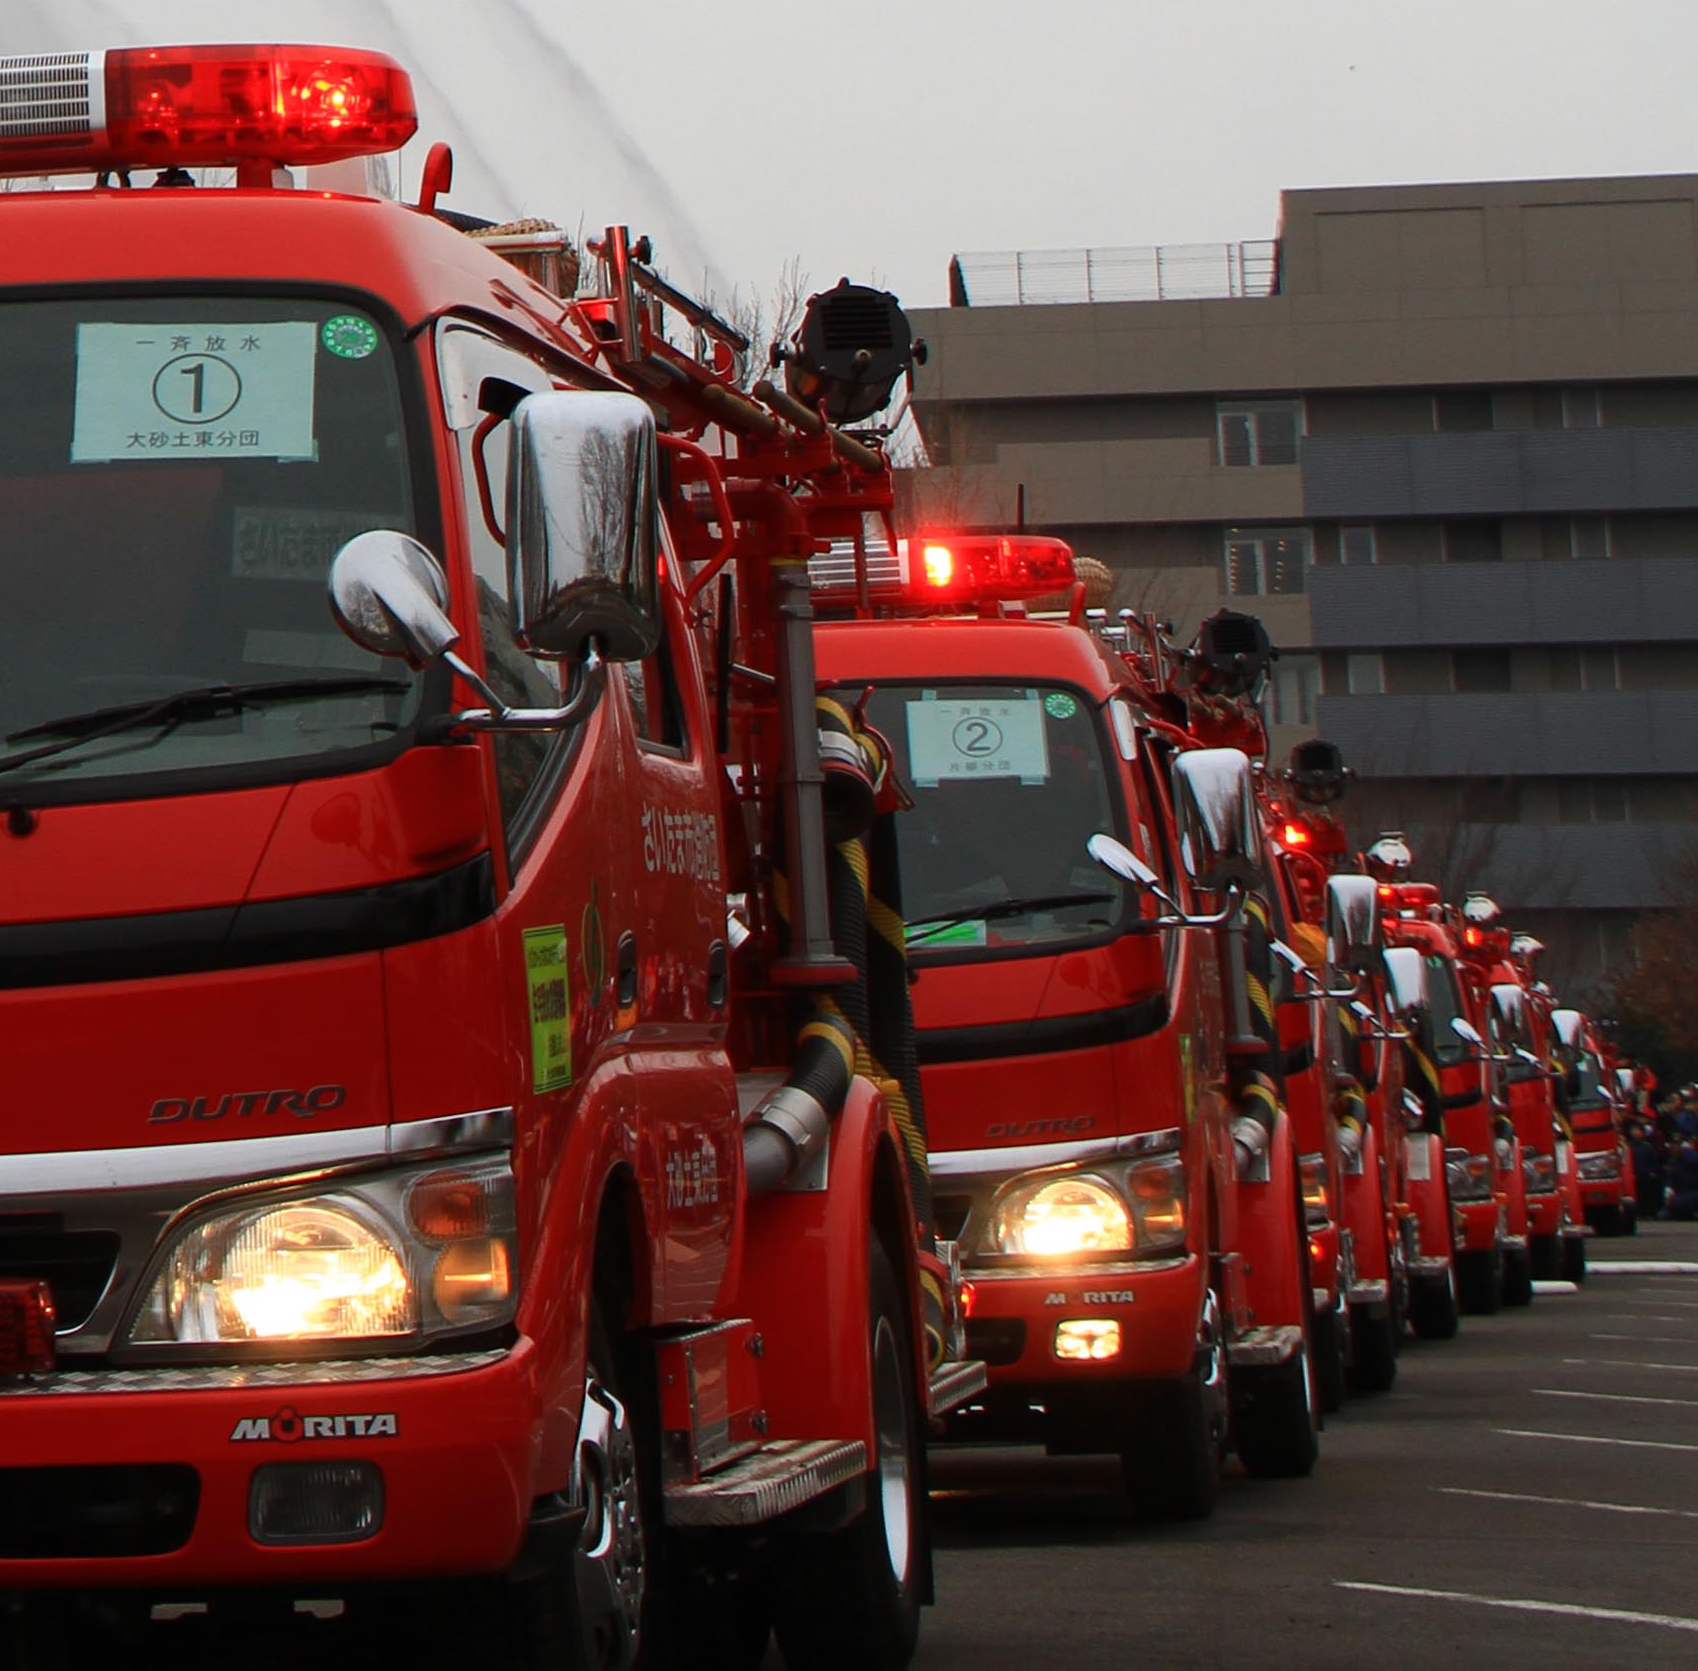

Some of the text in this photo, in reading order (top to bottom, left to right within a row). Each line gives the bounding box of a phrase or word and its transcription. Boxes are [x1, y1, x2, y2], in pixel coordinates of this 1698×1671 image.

[136, 335, 261, 352] 一斉放水
[126, 430, 259, 448] 大砂土東分団
[147, 1084, 346, 1123] DUTRO
[1044, 1290, 1135, 1306] MRITA
[230, 1408, 398, 1443] MORITA
